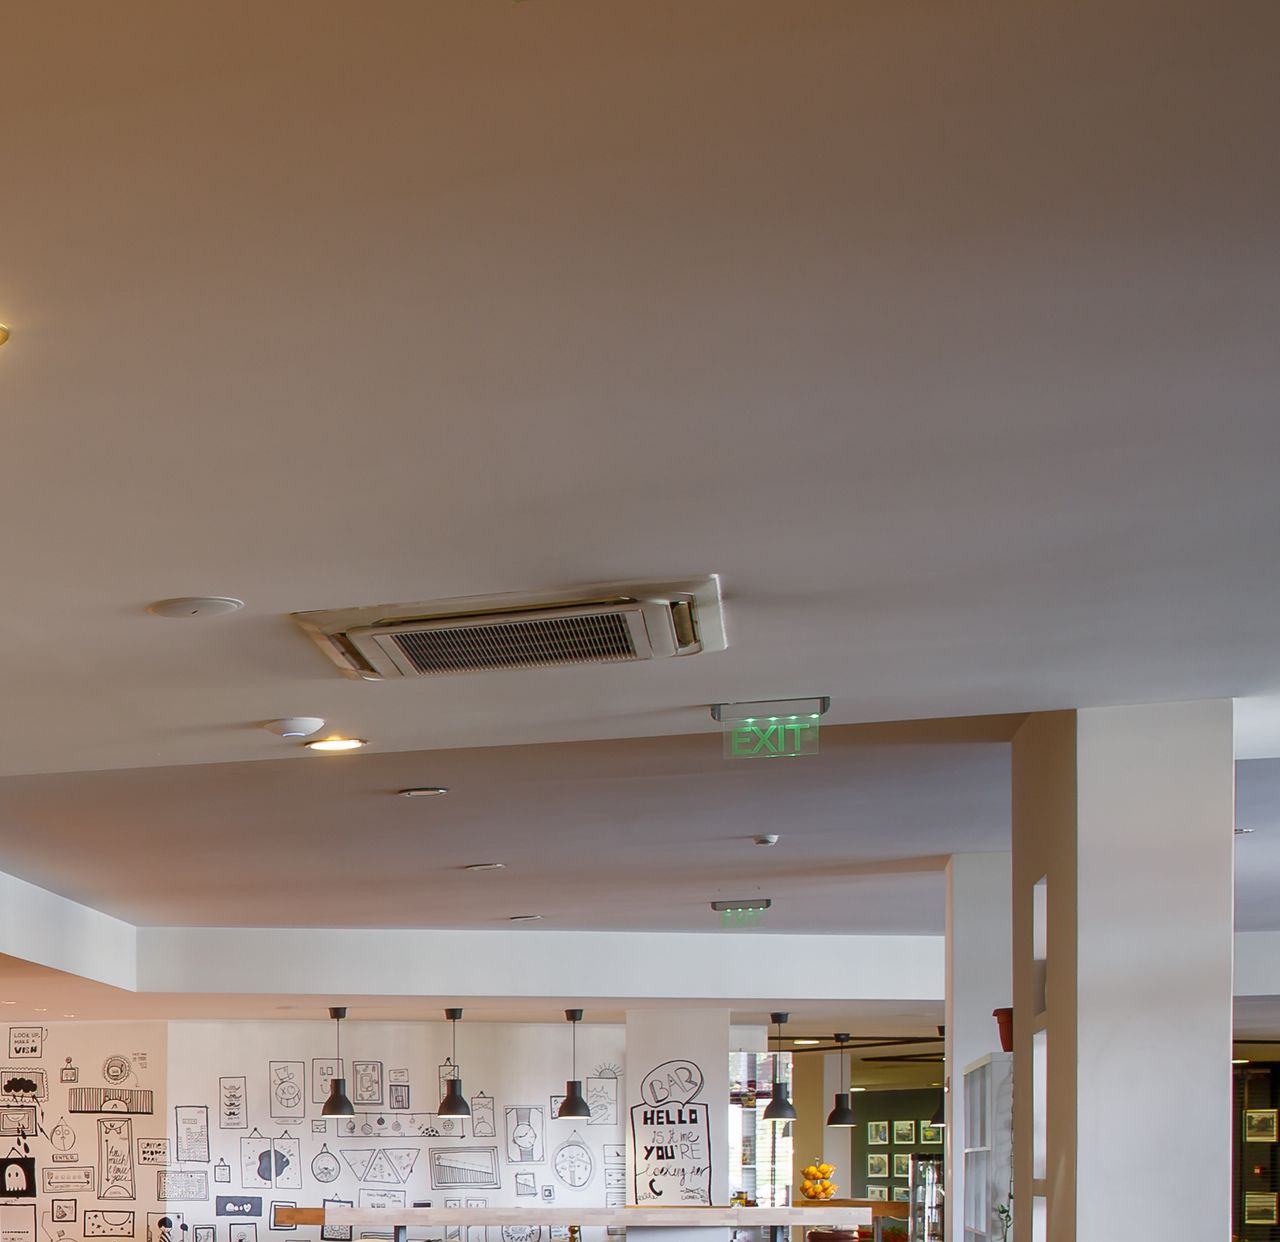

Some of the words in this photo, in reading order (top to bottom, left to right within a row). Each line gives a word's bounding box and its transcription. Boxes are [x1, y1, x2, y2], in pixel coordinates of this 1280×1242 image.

[732, 724, 809, 753] EXIT
[643, 1109, 698, 1125] HELLO
[652, 1131, 665, 1144] is
[680, 1131, 700, 1143] me
[644, 1143, 702, 1160] YOU'RE
